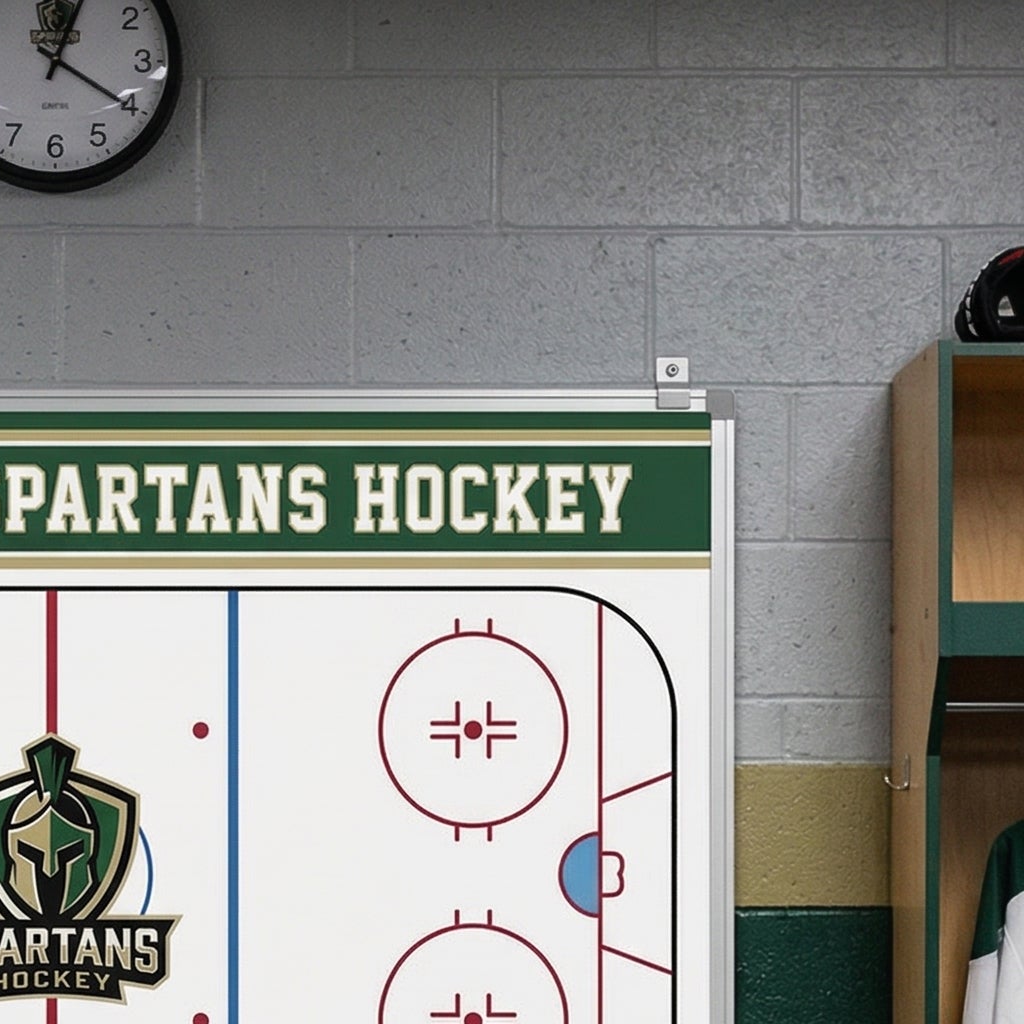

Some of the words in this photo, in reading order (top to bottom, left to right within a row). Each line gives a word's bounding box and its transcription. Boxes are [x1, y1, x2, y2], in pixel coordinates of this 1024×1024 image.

[121, 7, 139, 30] 2
[134, 49, 152, 73] 3
[121, 93, 139, 116] 4
[5, 123, 23, 147] 7
[47, 134, 64, 158] 6
[89, 123, 107, 147] 5
[353, 463, 633, 534] HOCKEY
